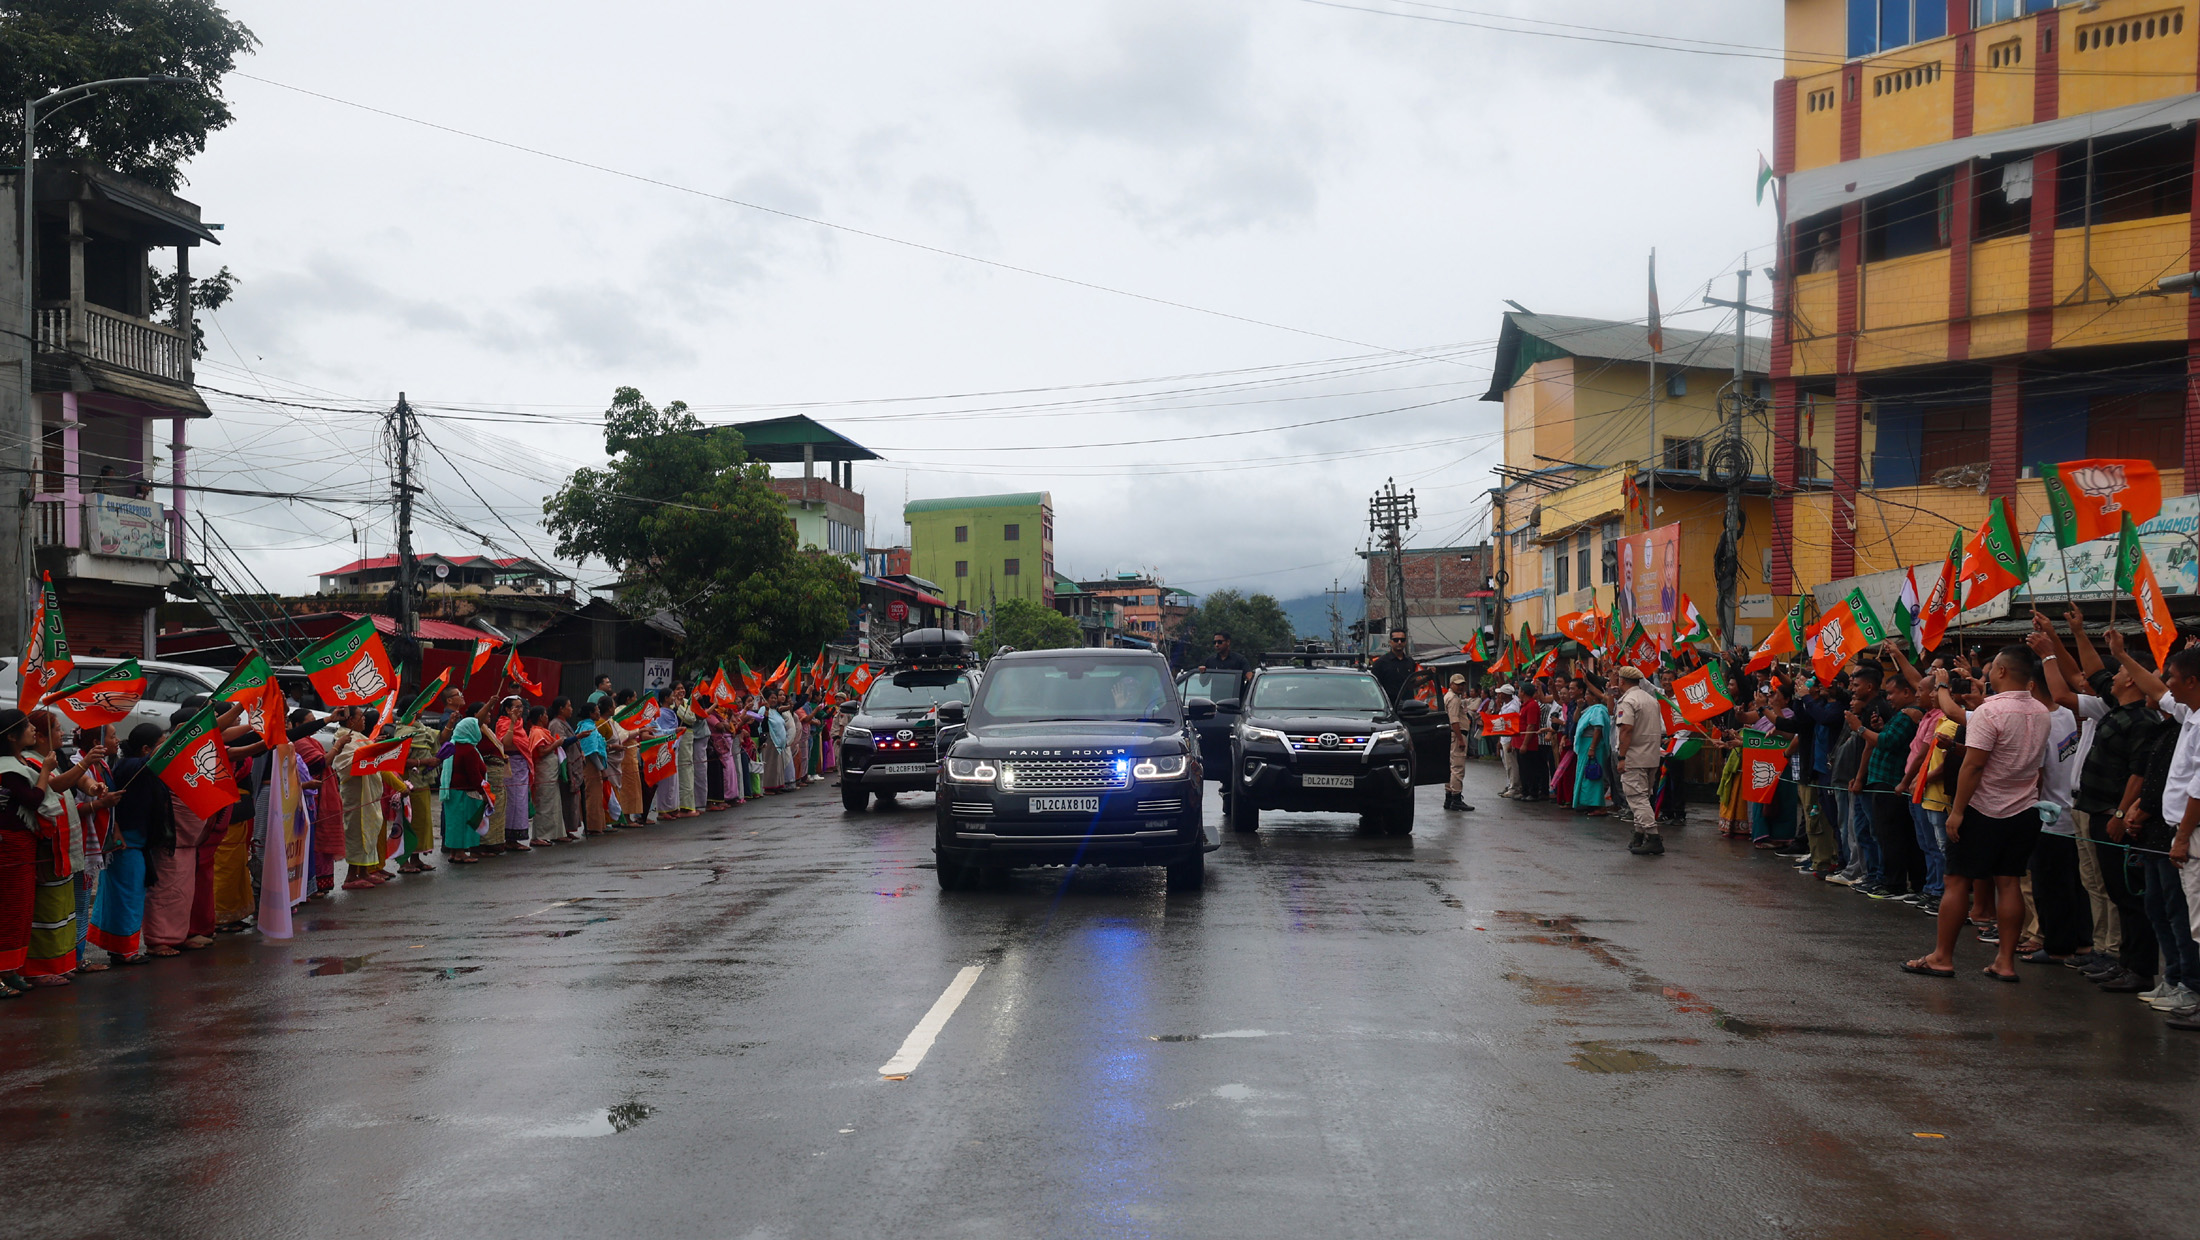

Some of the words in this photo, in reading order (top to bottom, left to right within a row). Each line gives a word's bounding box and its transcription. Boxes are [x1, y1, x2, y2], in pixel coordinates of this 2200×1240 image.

[2047, 476, 2073, 526] BJP
[45, 592, 68, 657] BJP
[318, 634, 360, 665] BJP
[647, 667, 670, 677] ATM
[163, 724, 202, 759] BJP
[1307, 777, 1353, 786] DL2CAY7425
[1035, 799, 1098, 810] DL2CAX8102
